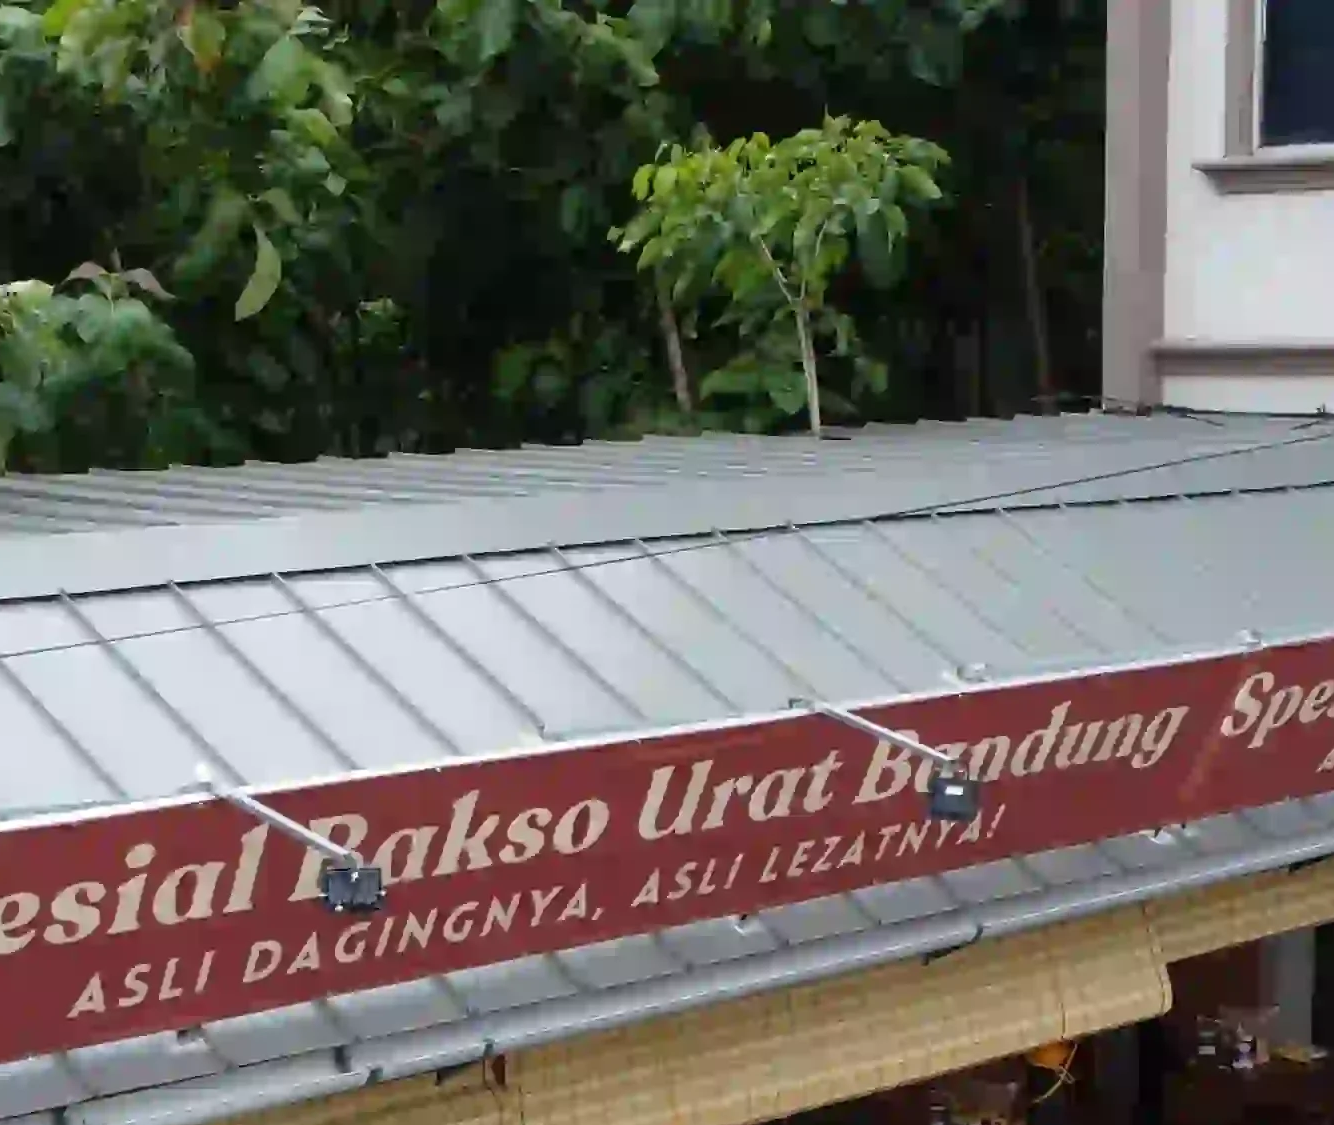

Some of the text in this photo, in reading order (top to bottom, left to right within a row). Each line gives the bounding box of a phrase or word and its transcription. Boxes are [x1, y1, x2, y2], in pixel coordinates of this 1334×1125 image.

[286, 789, 609, 902] Bakso
[637, 757, 843, 840] Urat
[851, 701, 1188, 804] Bandung
[68, 804, 1006, 1018] ASLI DAGINGNYA, ASLI LEZATNYA!
